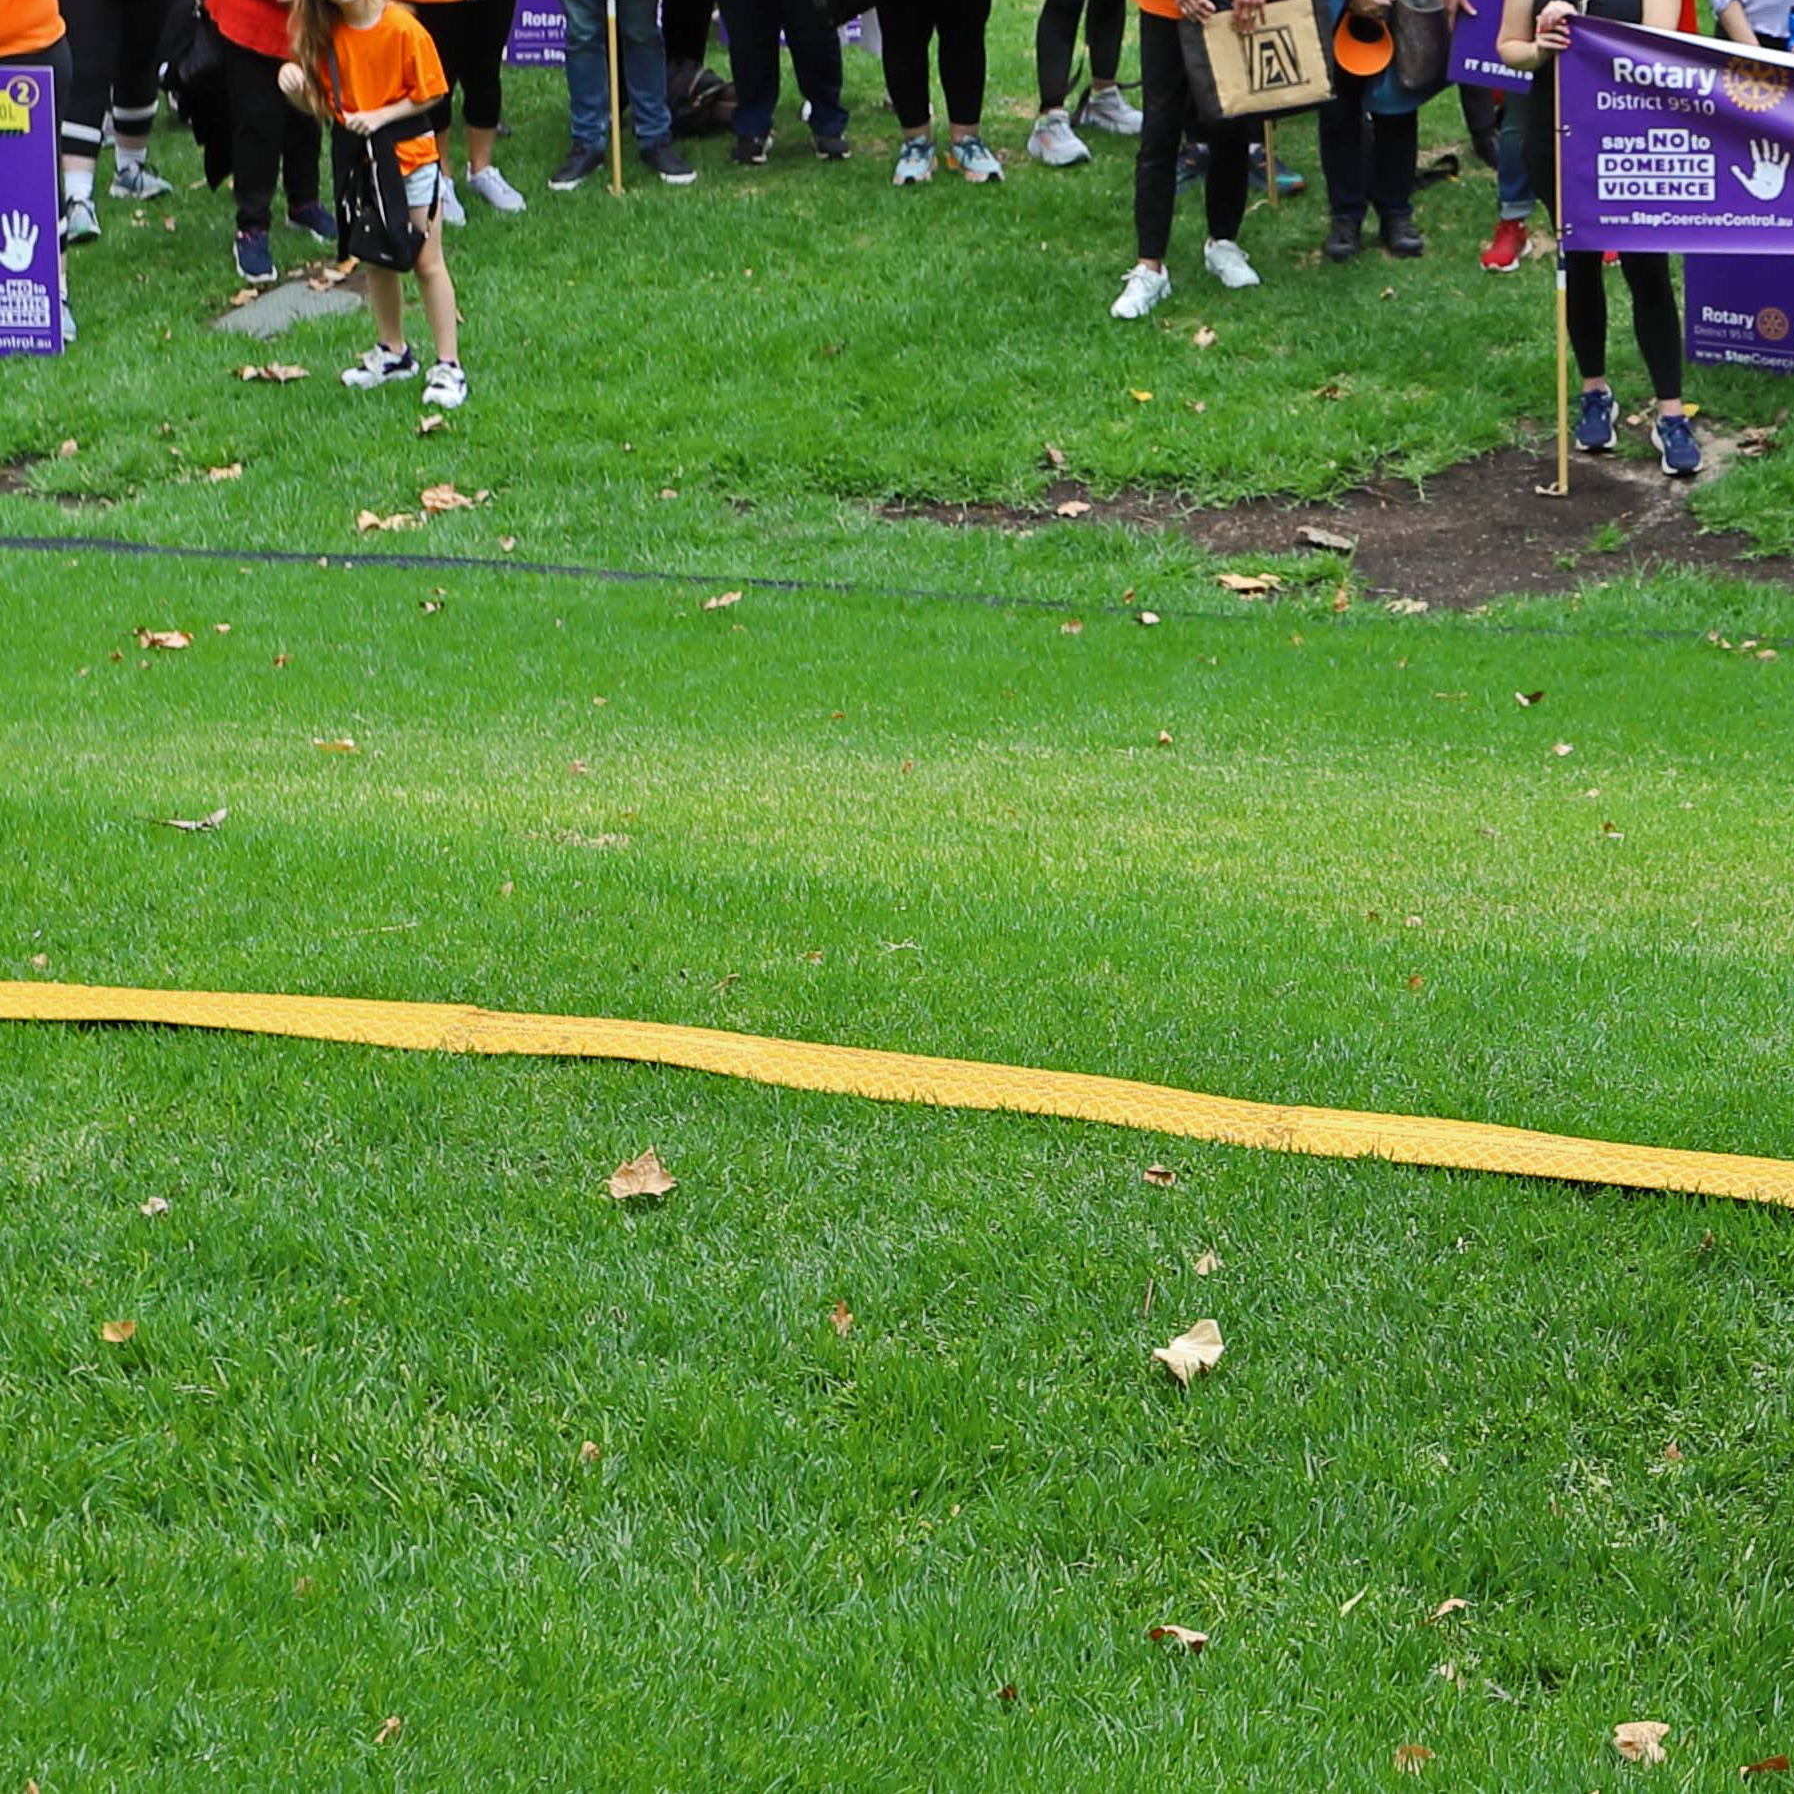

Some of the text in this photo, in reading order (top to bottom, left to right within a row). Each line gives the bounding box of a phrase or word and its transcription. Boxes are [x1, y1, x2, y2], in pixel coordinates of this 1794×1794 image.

[1465, 58, 1479, 71] IT
[1612, 57, 1717, 95] Rotary
[17, 81, 30, 103] 2
[1596, 91, 1716, 116] District 9510
[1601, 132, 1711, 153] says NO to
[1604, 157, 1710, 172] DOMESTIC
[1604, 181, 1710, 196] VIOLENCE
[1599, 211, 1793, 227] www.StopCoerciveControl.au
[33, 281, 46, 295] to
[1702, 306, 1755, 329] Rotary
